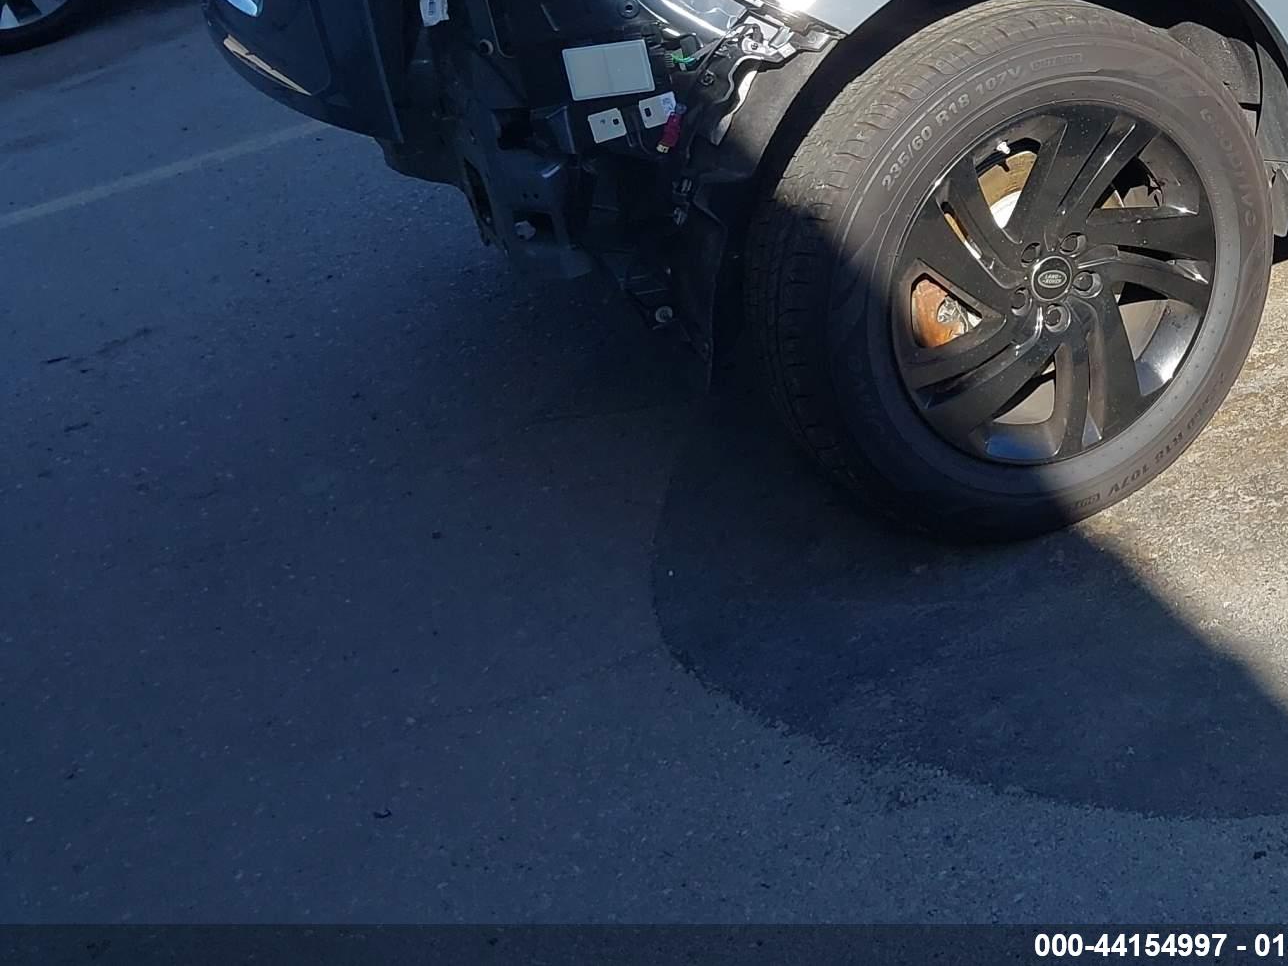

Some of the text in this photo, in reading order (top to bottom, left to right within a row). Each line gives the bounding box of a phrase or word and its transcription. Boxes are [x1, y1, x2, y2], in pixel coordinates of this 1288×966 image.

[882, 126, 933, 192] 235/60
[935, 93, 972, 127] R18
[975, 66, 1022, 95] 107V
[1109, 465, 1150, 496] 107V
